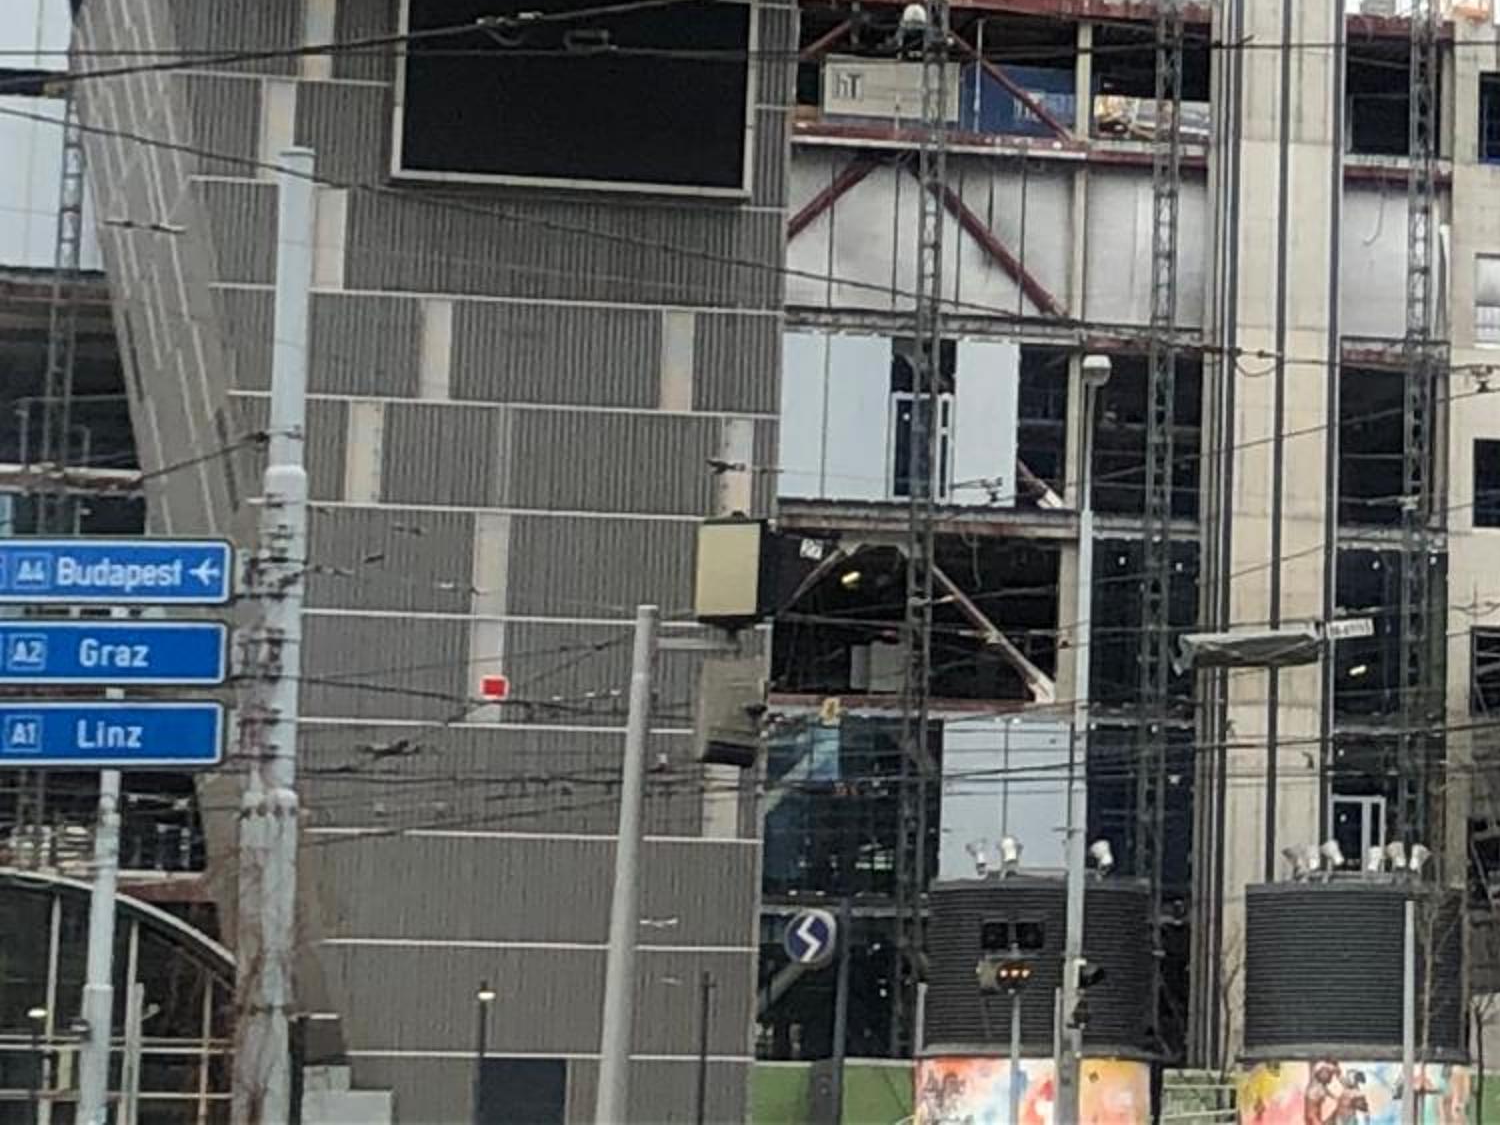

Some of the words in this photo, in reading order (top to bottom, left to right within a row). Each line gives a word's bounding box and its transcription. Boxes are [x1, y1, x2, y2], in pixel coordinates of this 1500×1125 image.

[57, 556, 183, 593] Budapest
[12, 640, 43, 662] A2
[79, 638, 149, 668] Graz
[10, 722, 37, 745] A1
[77, 719, 143, 749] Linz
